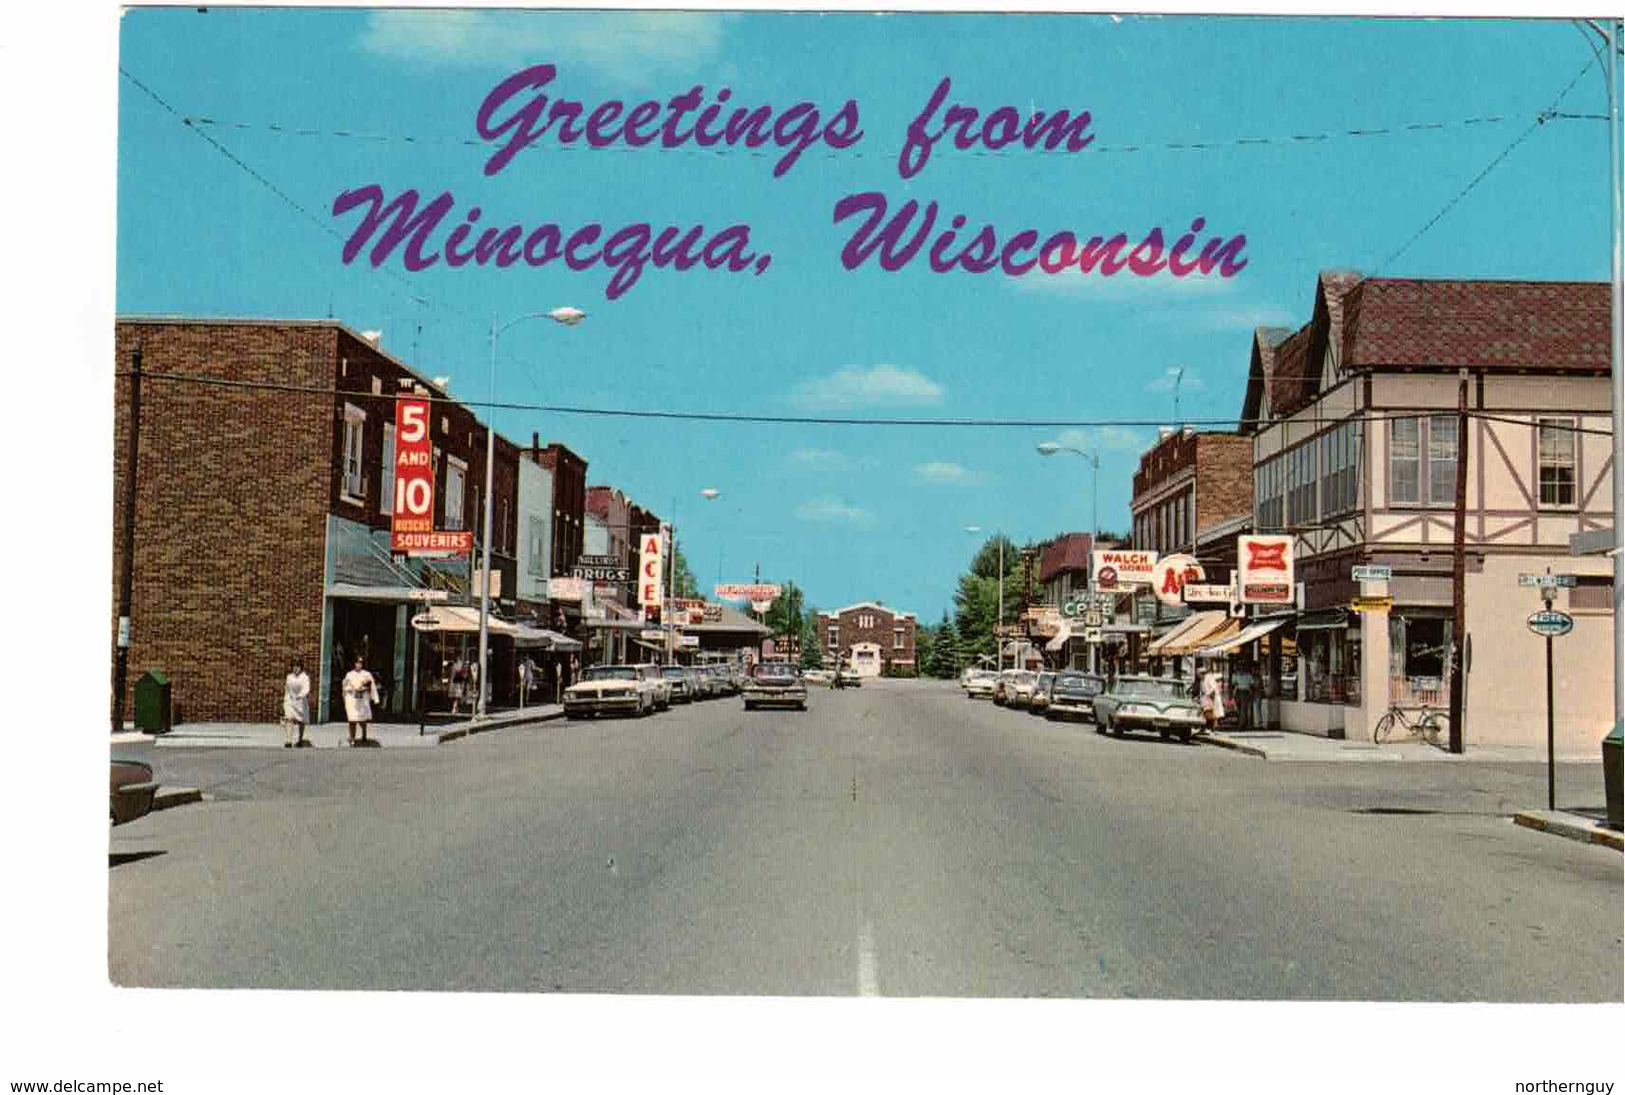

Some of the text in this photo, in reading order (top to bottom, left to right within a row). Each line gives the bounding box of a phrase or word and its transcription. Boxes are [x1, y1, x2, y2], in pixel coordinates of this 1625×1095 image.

[401, 406, 426, 442] 5
[399, 452, 428, 466] AND
[396, 477, 431, 514] 10
[397, 534, 467, 547] SOUVENIRS
[1103, 553, 1148, 563] WALCH
[573, 568, 627, 581] DRUGS
[644, 538, 658, 601] ACE
